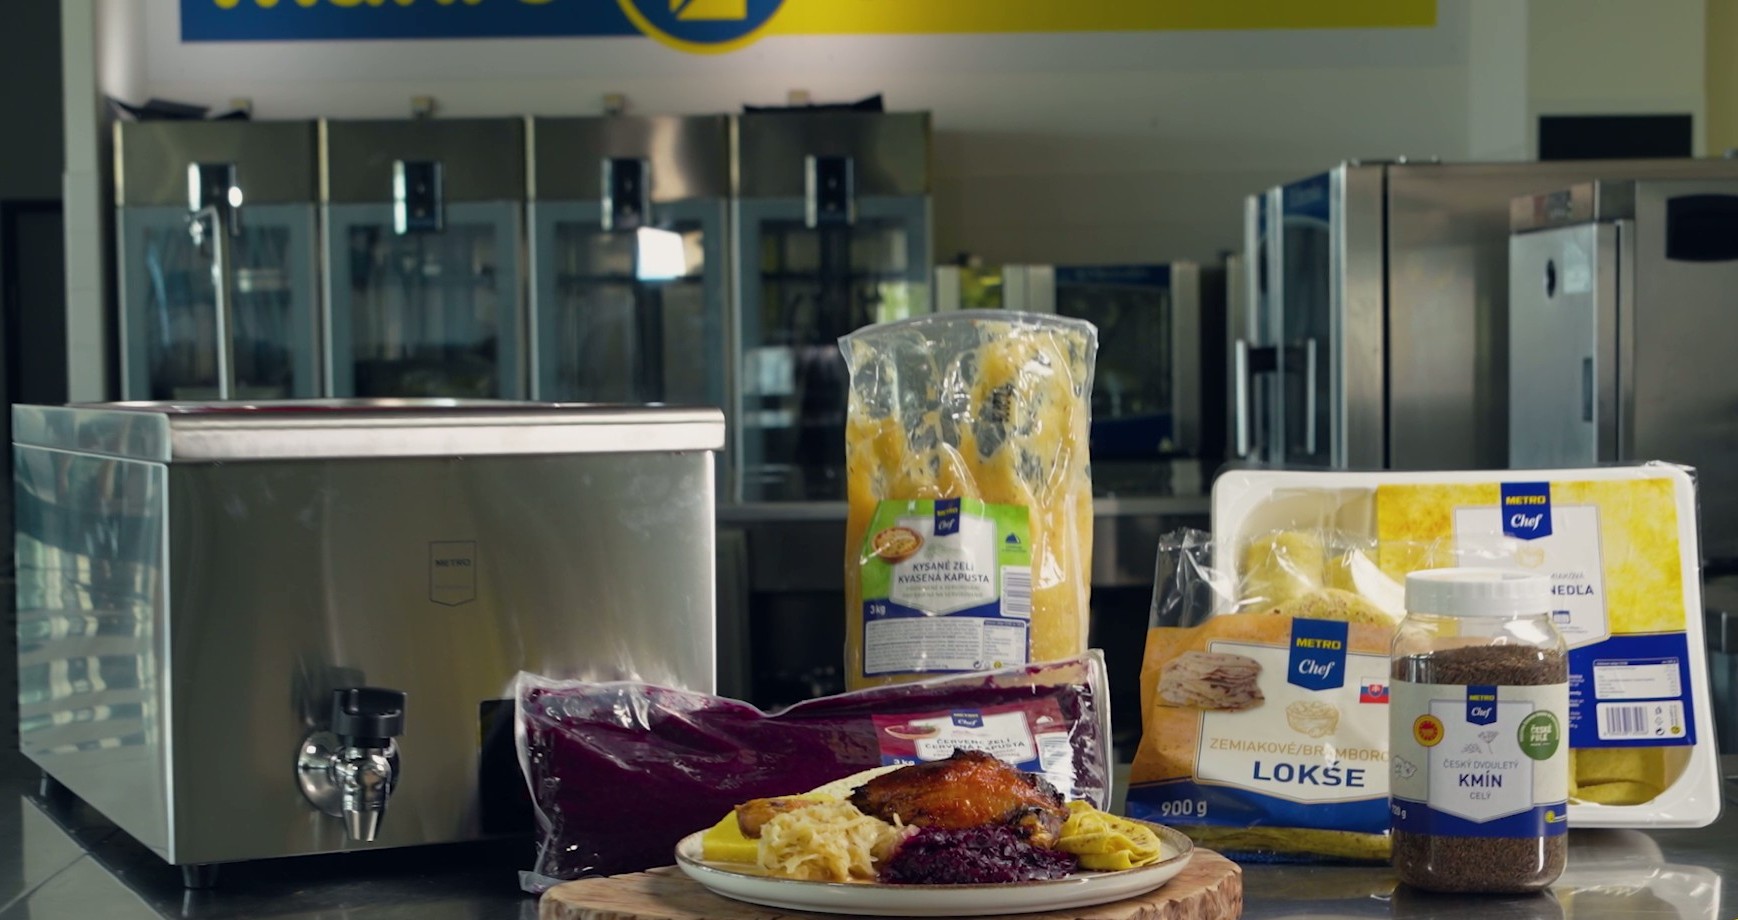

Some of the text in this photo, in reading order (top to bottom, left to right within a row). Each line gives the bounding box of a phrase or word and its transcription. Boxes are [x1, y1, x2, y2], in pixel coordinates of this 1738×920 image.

[1505, 495, 1546, 505] METRO
[1510, 513, 1543, 531] Chef
[435, 558, 471, 567] METRO
[912, 559, 951, 572] KYSANÉ
[898, 572, 990, 584] KVASENÁ KAPUSTA
[1296, 637, 1342, 650] METRO
[1298, 659, 1336, 680] Chef
[1471, 707, 1493, 719] Chef
[957, 718, 978, 727] Chef
[1443, 757, 1520, 770] ČESKÝ DVOULETÝ
[1459, 770, 1502, 788] KMÍN
[1470, 790, 1492, 801] CELÝ
[1161, 799, 1208, 817] 900 g
[1401, 809, 1407, 820] g
